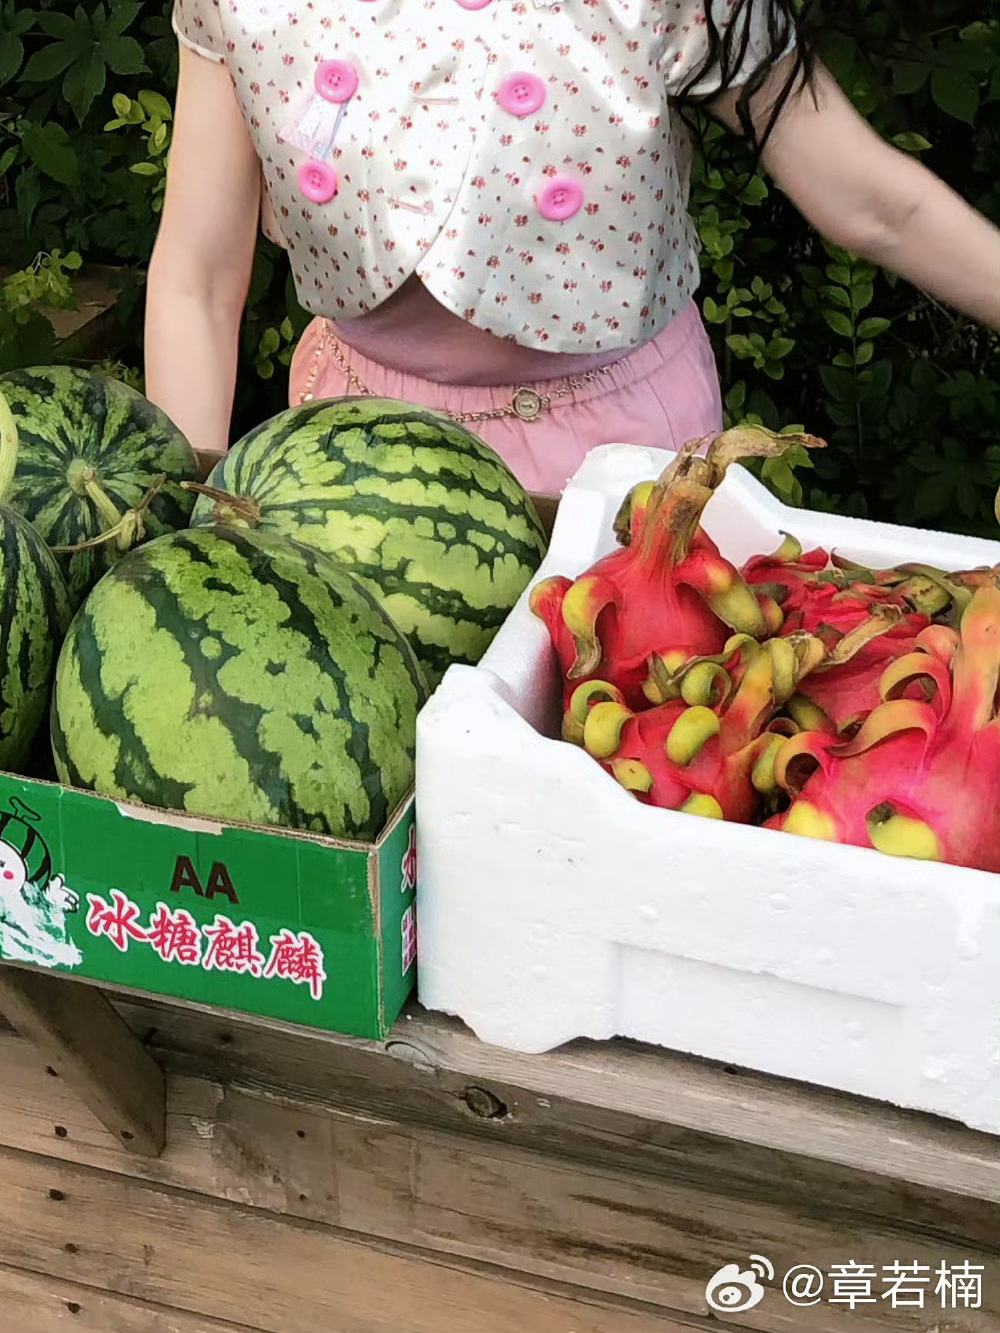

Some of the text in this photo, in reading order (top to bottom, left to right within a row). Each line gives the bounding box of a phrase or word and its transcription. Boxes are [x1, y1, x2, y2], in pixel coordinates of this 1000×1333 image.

[169, 855, 240, 905] AA
[87, 890, 326, 999] 冰糖麒麟
